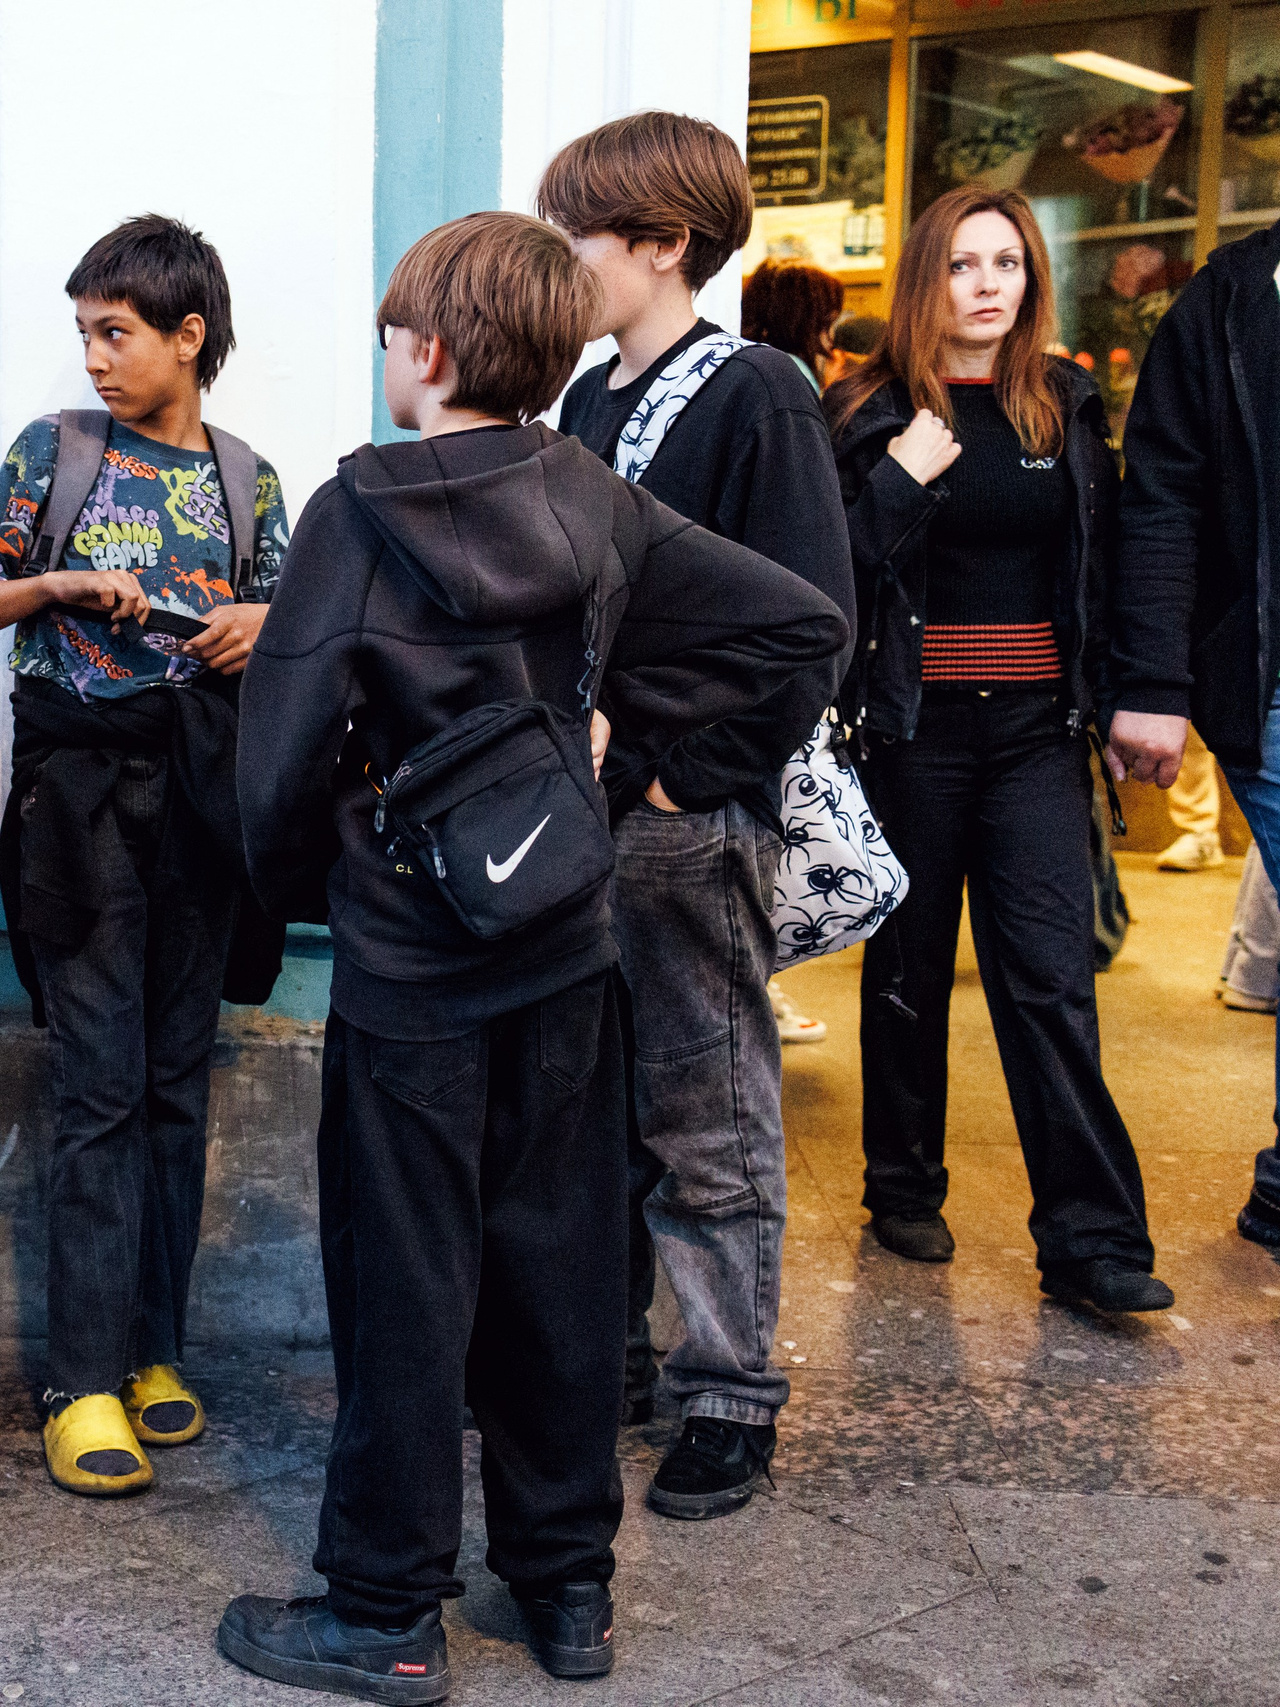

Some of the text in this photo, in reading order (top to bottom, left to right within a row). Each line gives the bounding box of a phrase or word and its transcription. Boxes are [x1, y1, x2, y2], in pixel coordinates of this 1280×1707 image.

[73, 521, 163, 556] GONNA
[90, 539, 159, 571] GAME
[398, 1662, 425, 1672] Supreme
